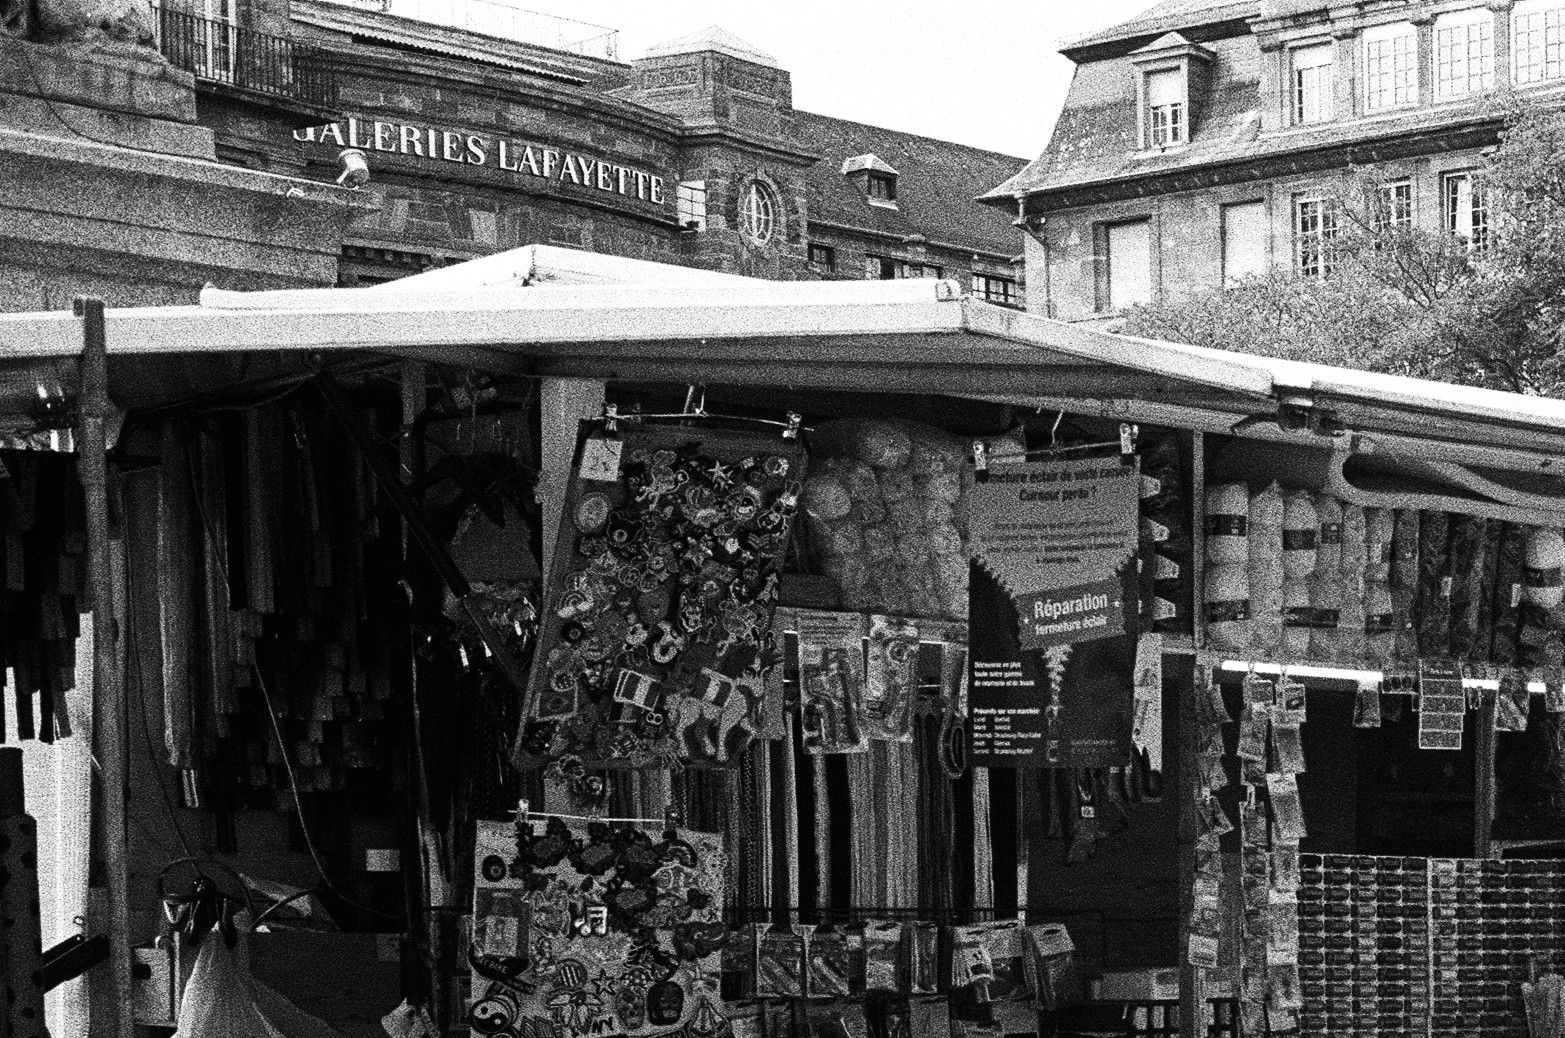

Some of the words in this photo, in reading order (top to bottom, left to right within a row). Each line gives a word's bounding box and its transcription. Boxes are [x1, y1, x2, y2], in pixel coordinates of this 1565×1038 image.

[498, 139, 665, 206] LAFAYETTE
[1034, 593, 1108, 620] Réparation
[1034, 619, 1081, 636] fermeture
[592, 1016, 615, 1033] NY
